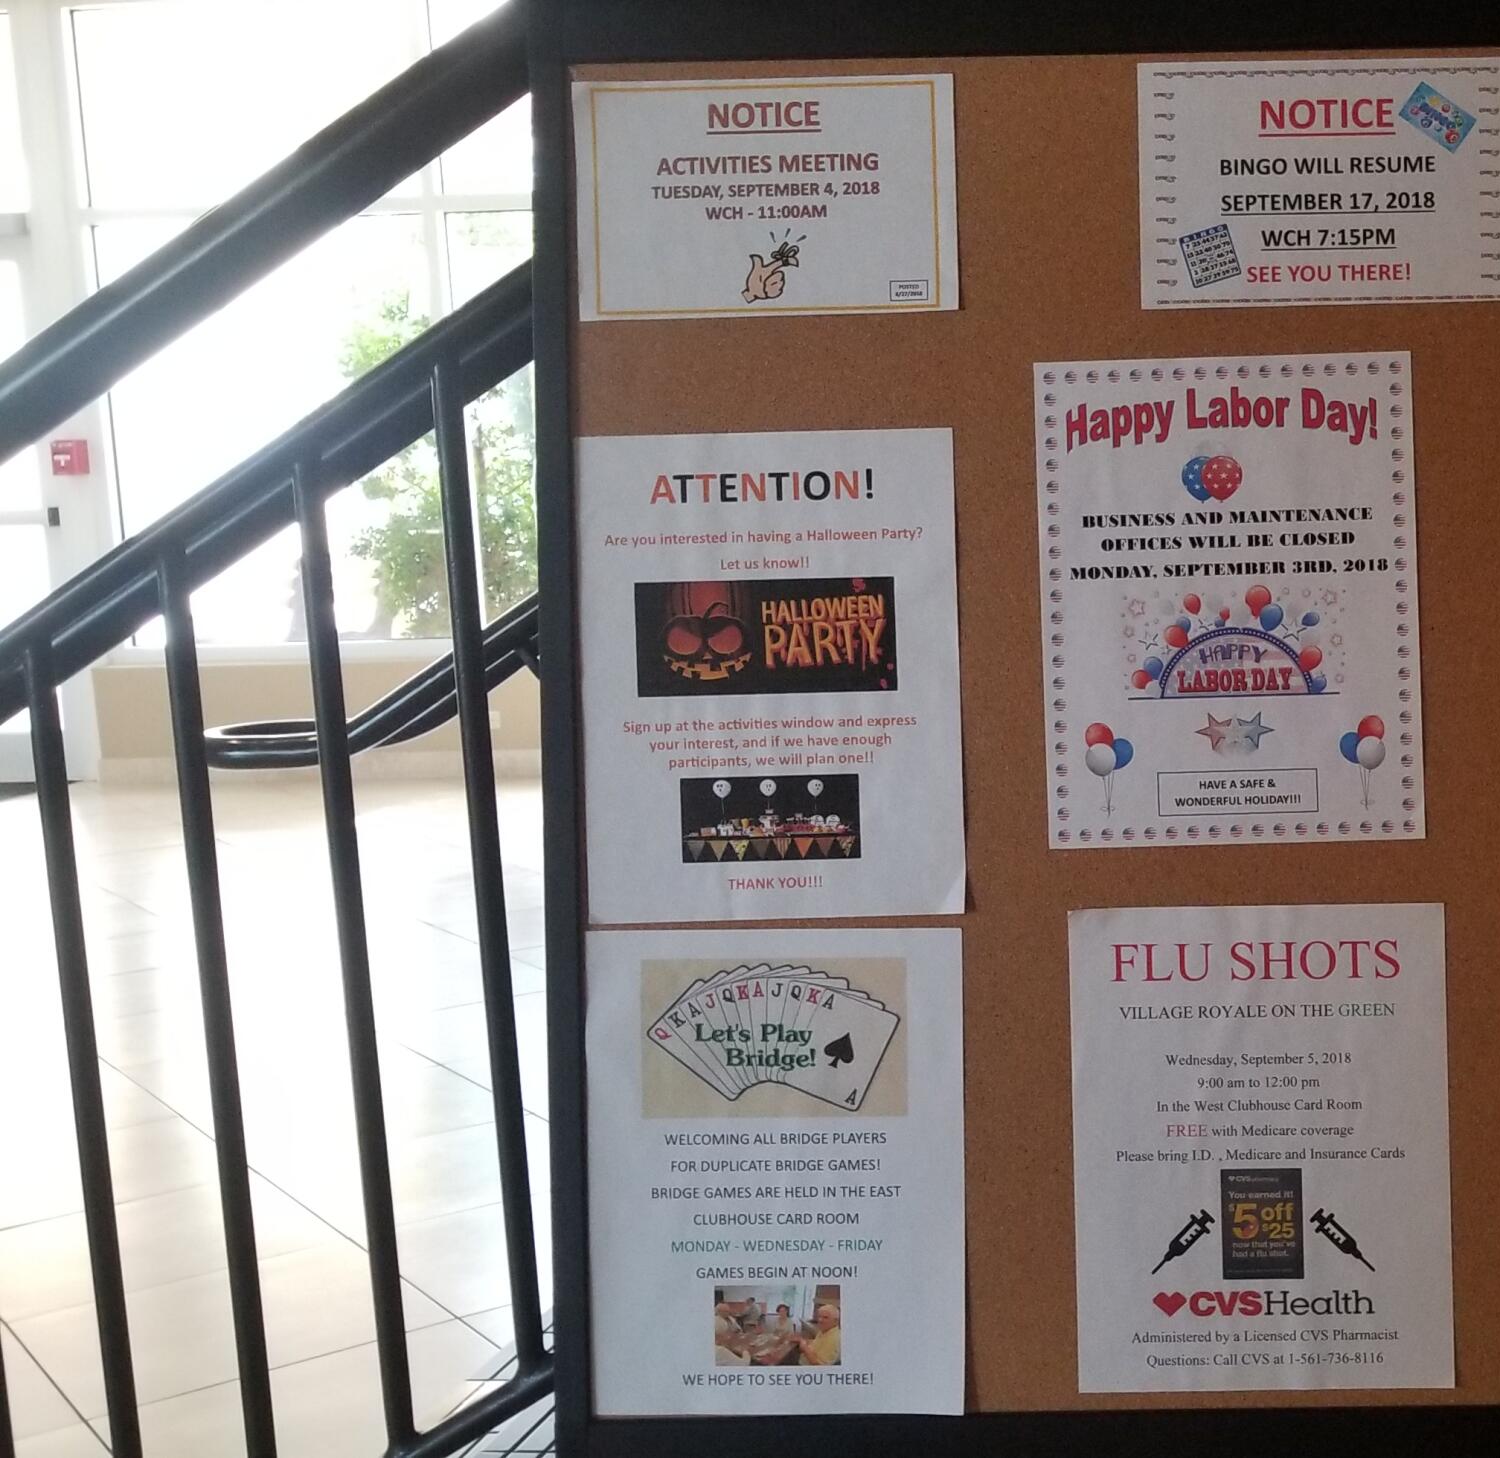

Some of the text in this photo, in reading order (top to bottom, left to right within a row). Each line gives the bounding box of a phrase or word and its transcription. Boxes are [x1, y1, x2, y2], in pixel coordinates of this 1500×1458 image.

[707, 100, 820, 128] NOTICE
[1260, 98, 1394, 129] NOTICE
[656, 152, 878, 175] ACTIVITIES MEETING
[1220, 155, 1435, 175] BINGO WILL RESUME
[651, 181, 880, 200] TUESDAY, SEPTEMBER 4, 2018
[1220, 191, 1435, 212] SEPTEMBER 17, 2018
[704, 206, 743, 220] WCH
[757, 204, 827, 219] 11:00AM
[1261, 227, 1395, 247] WCH 7:15PM
[1246, 262, 1410, 282] SEE YOU THERE!
[1066, 387, 1378, 454] Happy Labor Day!
[650, 467, 873, 504] ATTENTION!
[1082, 506, 1372, 528] BUSINESS AND MAINTENANCE
[604, 526, 922, 548] Are you interested in having a Halloween Party?
[720, 558, 740, 570] Let
[743, 559, 759, 569] us
[1163, 561, 1285, 577] SEPTEMBER
[1343, 558, 1388, 572] 2018
[761, 594, 883, 624] HALLOWEEN
[764, 617, 885, 667] PARTY
[1198, 644, 1269, 664] HAPPY
[1176, 666, 1293, 693] LABOR DAY
[623, 714, 916, 735] Sign up at the activities window and express
[1199, 778, 1276, 789] HAVE A SAFE &
[1174, 793, 1300, 806] WONDERFUL HOLIDAY!!!
[727, 875, 822, 890] THANK YOU!!!
[1111, 939, 1400, 981] FLU SHOTS
[1119, 1002, 1395, 1019] VILLAGE ROYALE ON THE GREEN
[694, 1022, 813, 1046] Let's Play
[726, 1048, 817, 1071] Bridge!
[1165, 1052, 1351, 1068] Wednesday, September 5, 2018
[693, 1212, 859, 1225] CLUBHOUSE CARD ROOM
[1261, 1202, 1294, 1220] off
[695, 1265, 857, 1278] GAMES BEGIN AT NOON!
[1146, 1351, 1383, 1368] Questions: Call CVS at 1-561-736-8116
